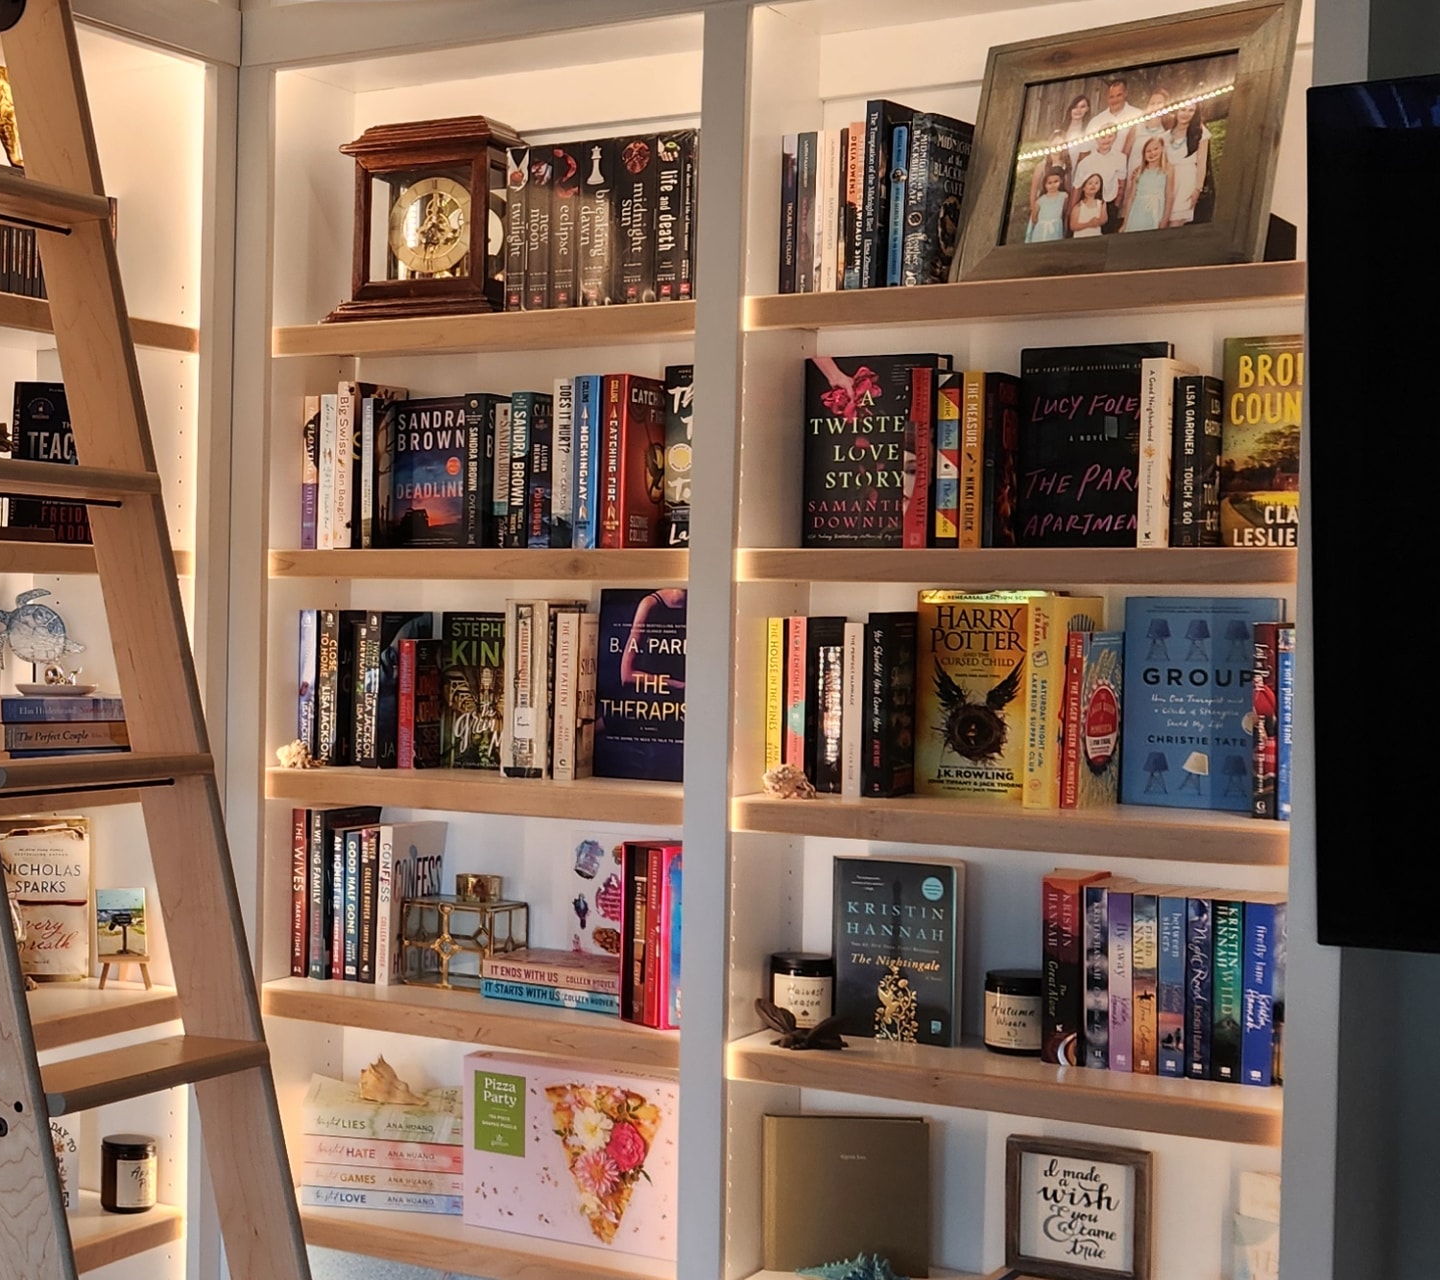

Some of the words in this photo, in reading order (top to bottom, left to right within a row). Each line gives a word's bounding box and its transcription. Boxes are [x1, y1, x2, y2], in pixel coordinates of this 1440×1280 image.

[505, 201, 524, 258] twilight
[592, 188, 609, 259] breaking
[632, 182, 644, 254] midnight
[559, 385, 571, 408] DOES
[861, 390, 875, 406] A
[966, 382, 979, 400] THE
[1184, 385, 1196, 407] LISA
[339, 396, 349, 415] Big
[1032, 396, 1083, 422] LUCY
[397, 408, 466, 431] SANDRA
[966, 403, 979, 448] MEASURE
[339, 418, 349, 456] Swiss
[397, 431, 465, 452] BROWN
[468, 427, 478, 458] SANDRA
[512, 411, 526, 459] SANDRA
[578, 425, 589, 500] MOCKINGJAY
[833, 443, 899, 462] LOVE
[468, 461, 478, 491] BROWN
[510, 462, 525, 506] BROWN
[1026, 466, 1073, 499] THE
[1183, 466, 1194, 498] TOUCH
[561, 621, 569, 636] THE
[936, 605, 1022, 631] HARRY
[930, 628, 1026, 653] POTTER
[320, 648, 329, 678] HOME
[328, 640, 337, 671] CLOSE
[561, 640, 569, 669] SILENT
[769, 641, 778, 674] HOUSE
[941, 657, 979, 667] CURSED
[982, 657, 1015, 667] CHILD
[560, 673, 569, 707] PATIENT
[633, 673, 670, 695] THE
[1069, 681, 1078, 696] THE
[321, 686, 331, 709] LISA
[1068, 697, 1077, 721] LAGER
[17, 731, 34, 742] The
[35, 731, 61, 743] Perfect
[62, 729, 89, 743] Couple
[320, 710, 330, 761] JACKSON
[363, 713, 372, 758] JACKSON
[1147, 734, 1209, 746] CHRISTIE
[1215, 736, 1247, 747] TATE
[955, 770, 1014, 780] ROWLING
[295, 822, 303, 841] THE
[295, 846, 303, 891] WIVES
[347, 841, 356, 874] GOOD
[380, 843, 391, 903] CONFESS
[394, 854, 443, 902] CONFESS
[15, 879, 67, 894] SPARKS
[313, 867, 321, 904] FAMILY
[346, 904, 355, 934] GONE
[847, 901, 945, 921] KRISTIN
[847, 922, 944, 942] HANNAH
[1228, 907, 1239, 969] KRISTIN
[1254, 926, 1267, 957] firefly
[490, 965, 499, 977] IT
[500, 967, 523, 981] ENDS
[524, 969, 544, 982] WITH
[546, 971, 559, 983] US
[851, 953, 872, 965] The
[875, 954, 940, 972] Nightingale
[484, 981, 493, 993] IT
[494, 984, 524, 997] STARTS
[526, 988, 546, 1000] WITH
[548, 990, 560, 1002] US
[484, 1077, 516, 1093] Pizza
[483, 1090, 517, 1108] Party
[341, 1119, 366, 1131] LIES
[386, 1121, 404, 1132] ANA
[346, 1148, 376, 1160] HATE
[387, 1150, 405, 1159] ANA
[339, 1173, 376, 1185] GAMES
[1063, 1166, 1101, 1182] made
[339, 1193, 367, 1204] LOVE
[1037, 1183, 1120, 1211] wish
[1068, 1211, 1098, 1231] you
[1080, 1222, 1117, 1241] came
